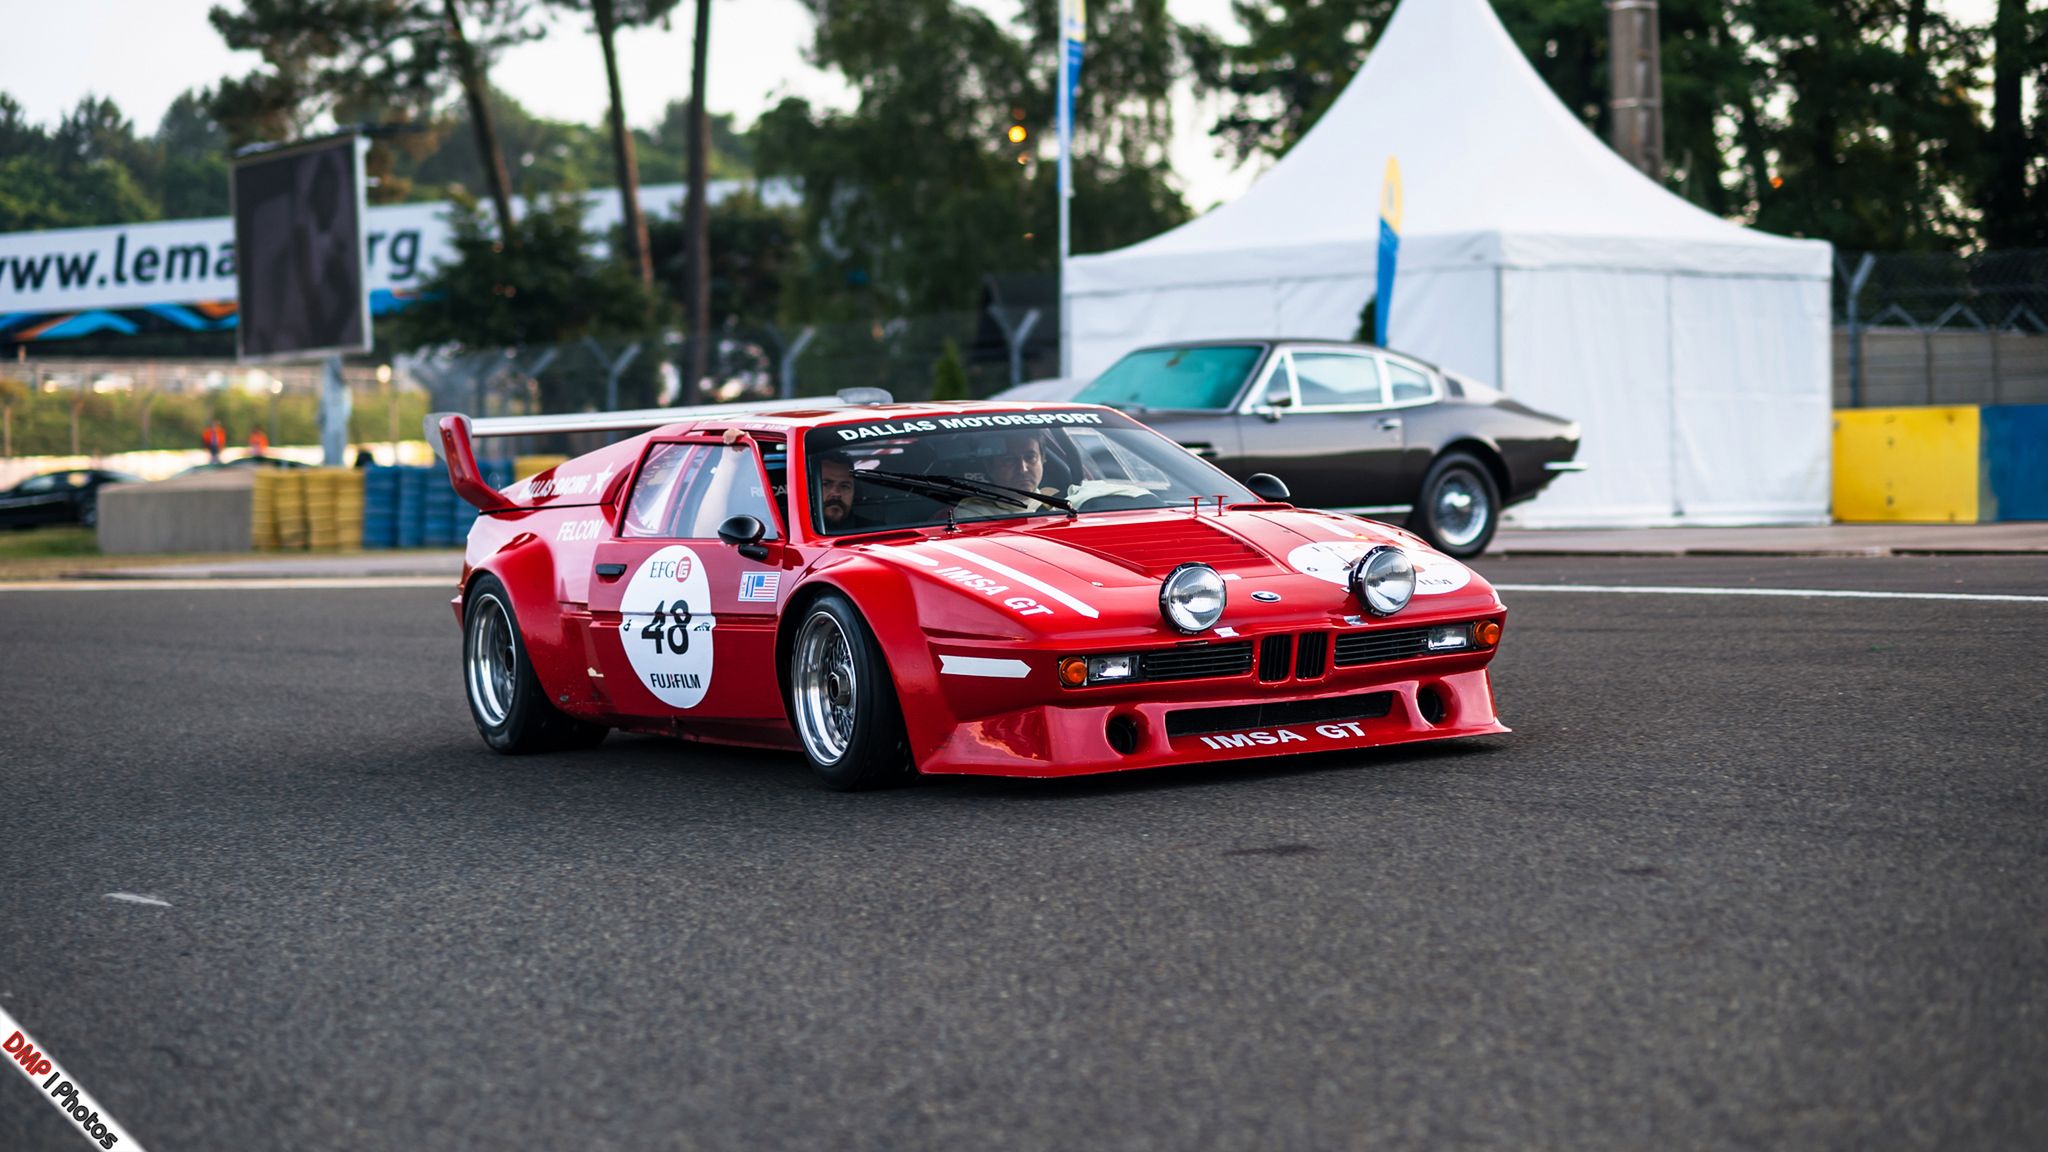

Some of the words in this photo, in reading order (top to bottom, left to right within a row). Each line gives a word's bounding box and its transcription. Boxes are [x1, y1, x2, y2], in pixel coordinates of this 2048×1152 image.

[837, 420, 938, 441] DALLAS
[938, 412, 1103, 431] MOTORSPORT
[556, 519, 605, 541] FELCON
[650, 561, 676, 578] EFG
[934, 566, 1009, 596] IMSA
[1003, 597, 1055, 616] GT
[641, 599, 692, 655] 48
[650, 673, 702, 689] FUJIFILM
[1200, 729, 1308, 750] IMSA
[1315, 722, 1366, 739] GT
